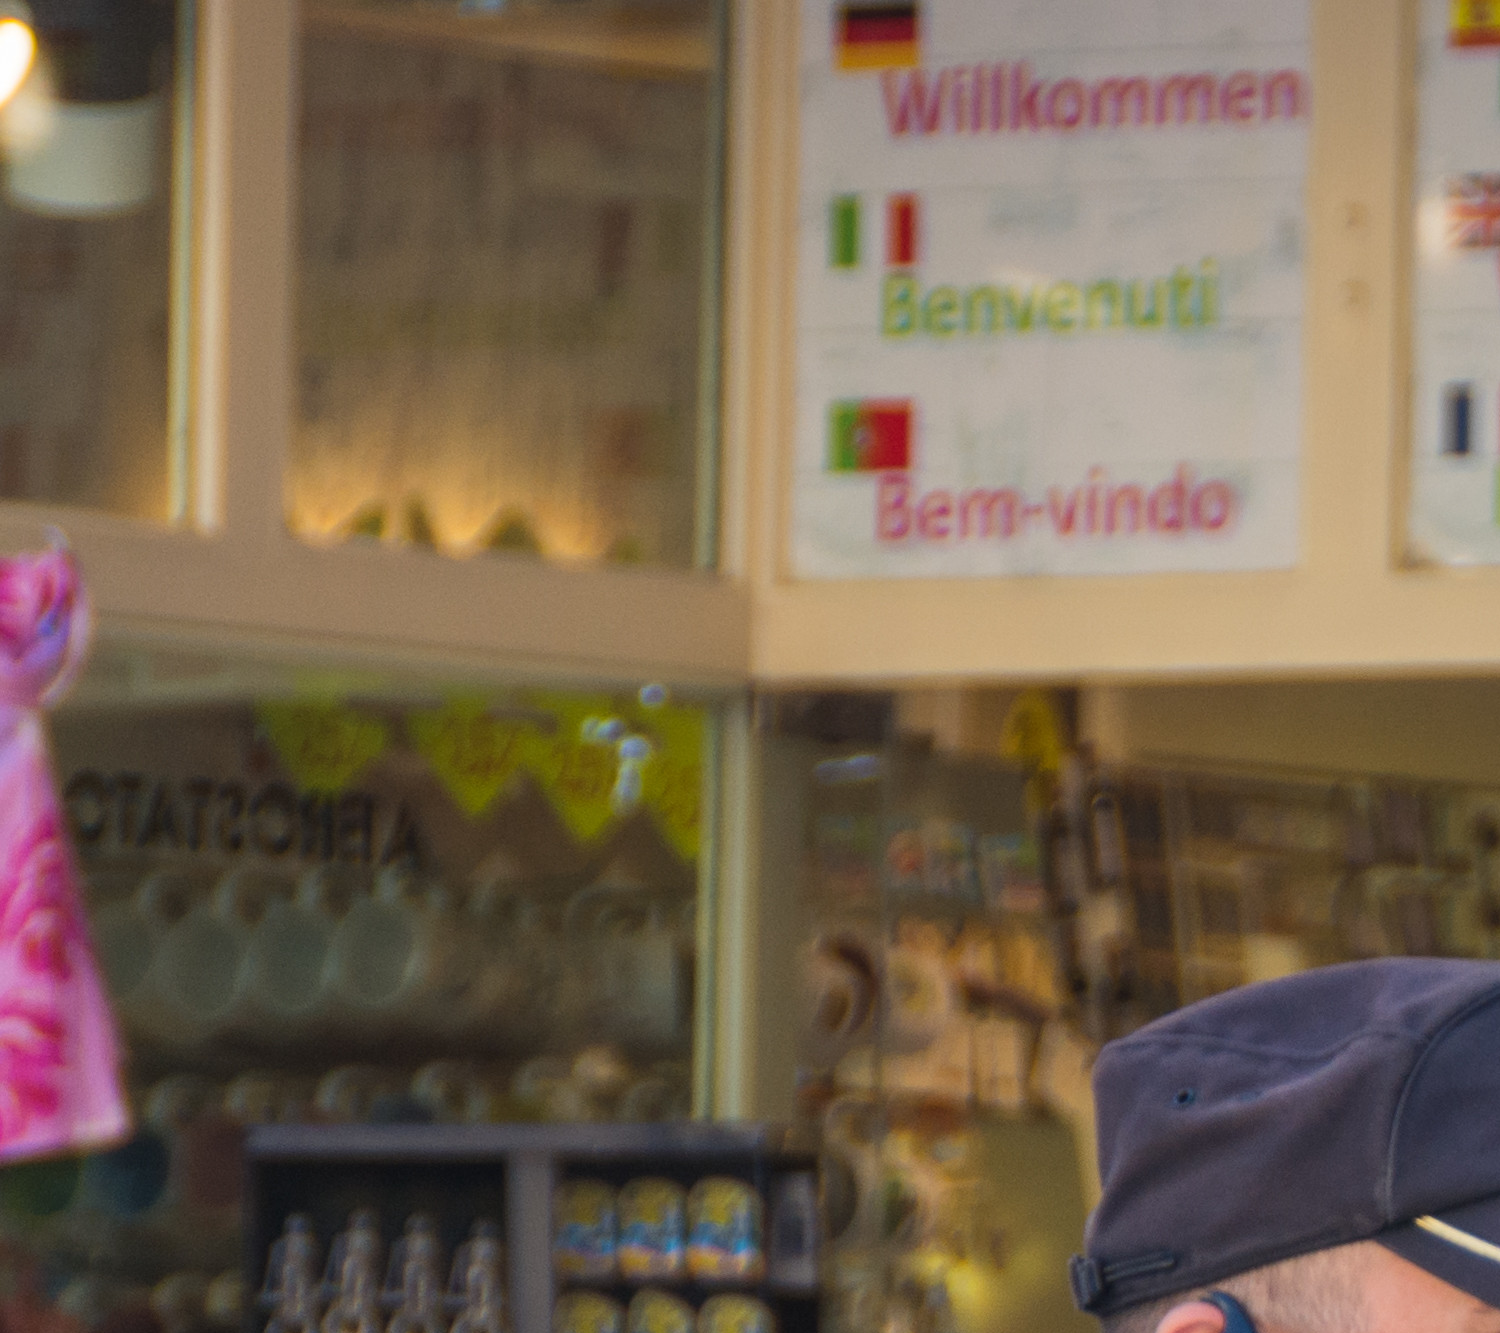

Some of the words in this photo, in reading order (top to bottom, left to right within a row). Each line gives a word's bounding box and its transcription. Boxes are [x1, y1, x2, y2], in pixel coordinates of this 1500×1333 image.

[882, 62, 1308, 138] Willkommen
[880, 258, 1220, 340] Benvenuti
[874, 464, 1236, 544] Bem-vindo
